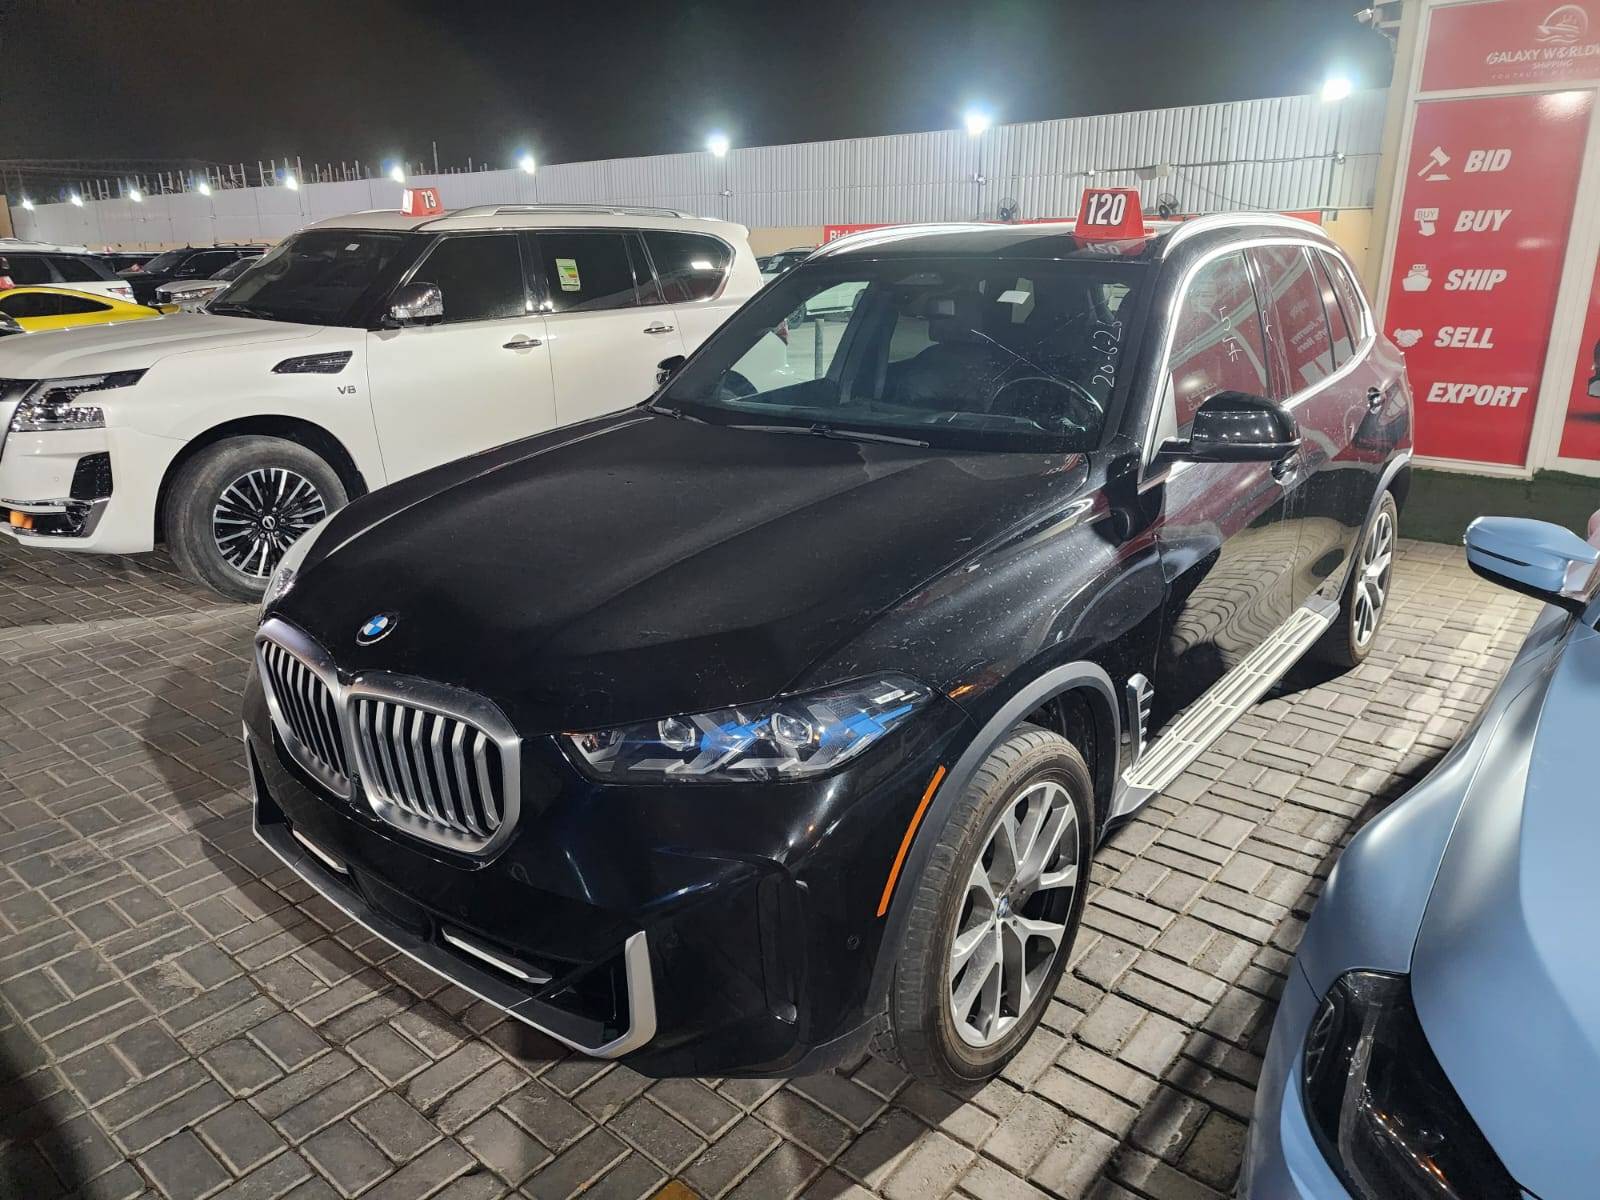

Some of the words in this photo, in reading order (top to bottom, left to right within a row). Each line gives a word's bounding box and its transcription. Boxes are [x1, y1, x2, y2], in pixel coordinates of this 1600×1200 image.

[1486, 49, 1541, 65] GALAXY
[1464, 149, 1512, 173] BID
[1087, 193, 1127, 226] 120
[1454, 209, 1512, 233] BUY
[1444, 269, 1507, 291] SHIP
[1434, 326, 1494, 349] SELL
[337, 385, 357, 395] V8
[1426, 382, 1529, 408] EXPORT
